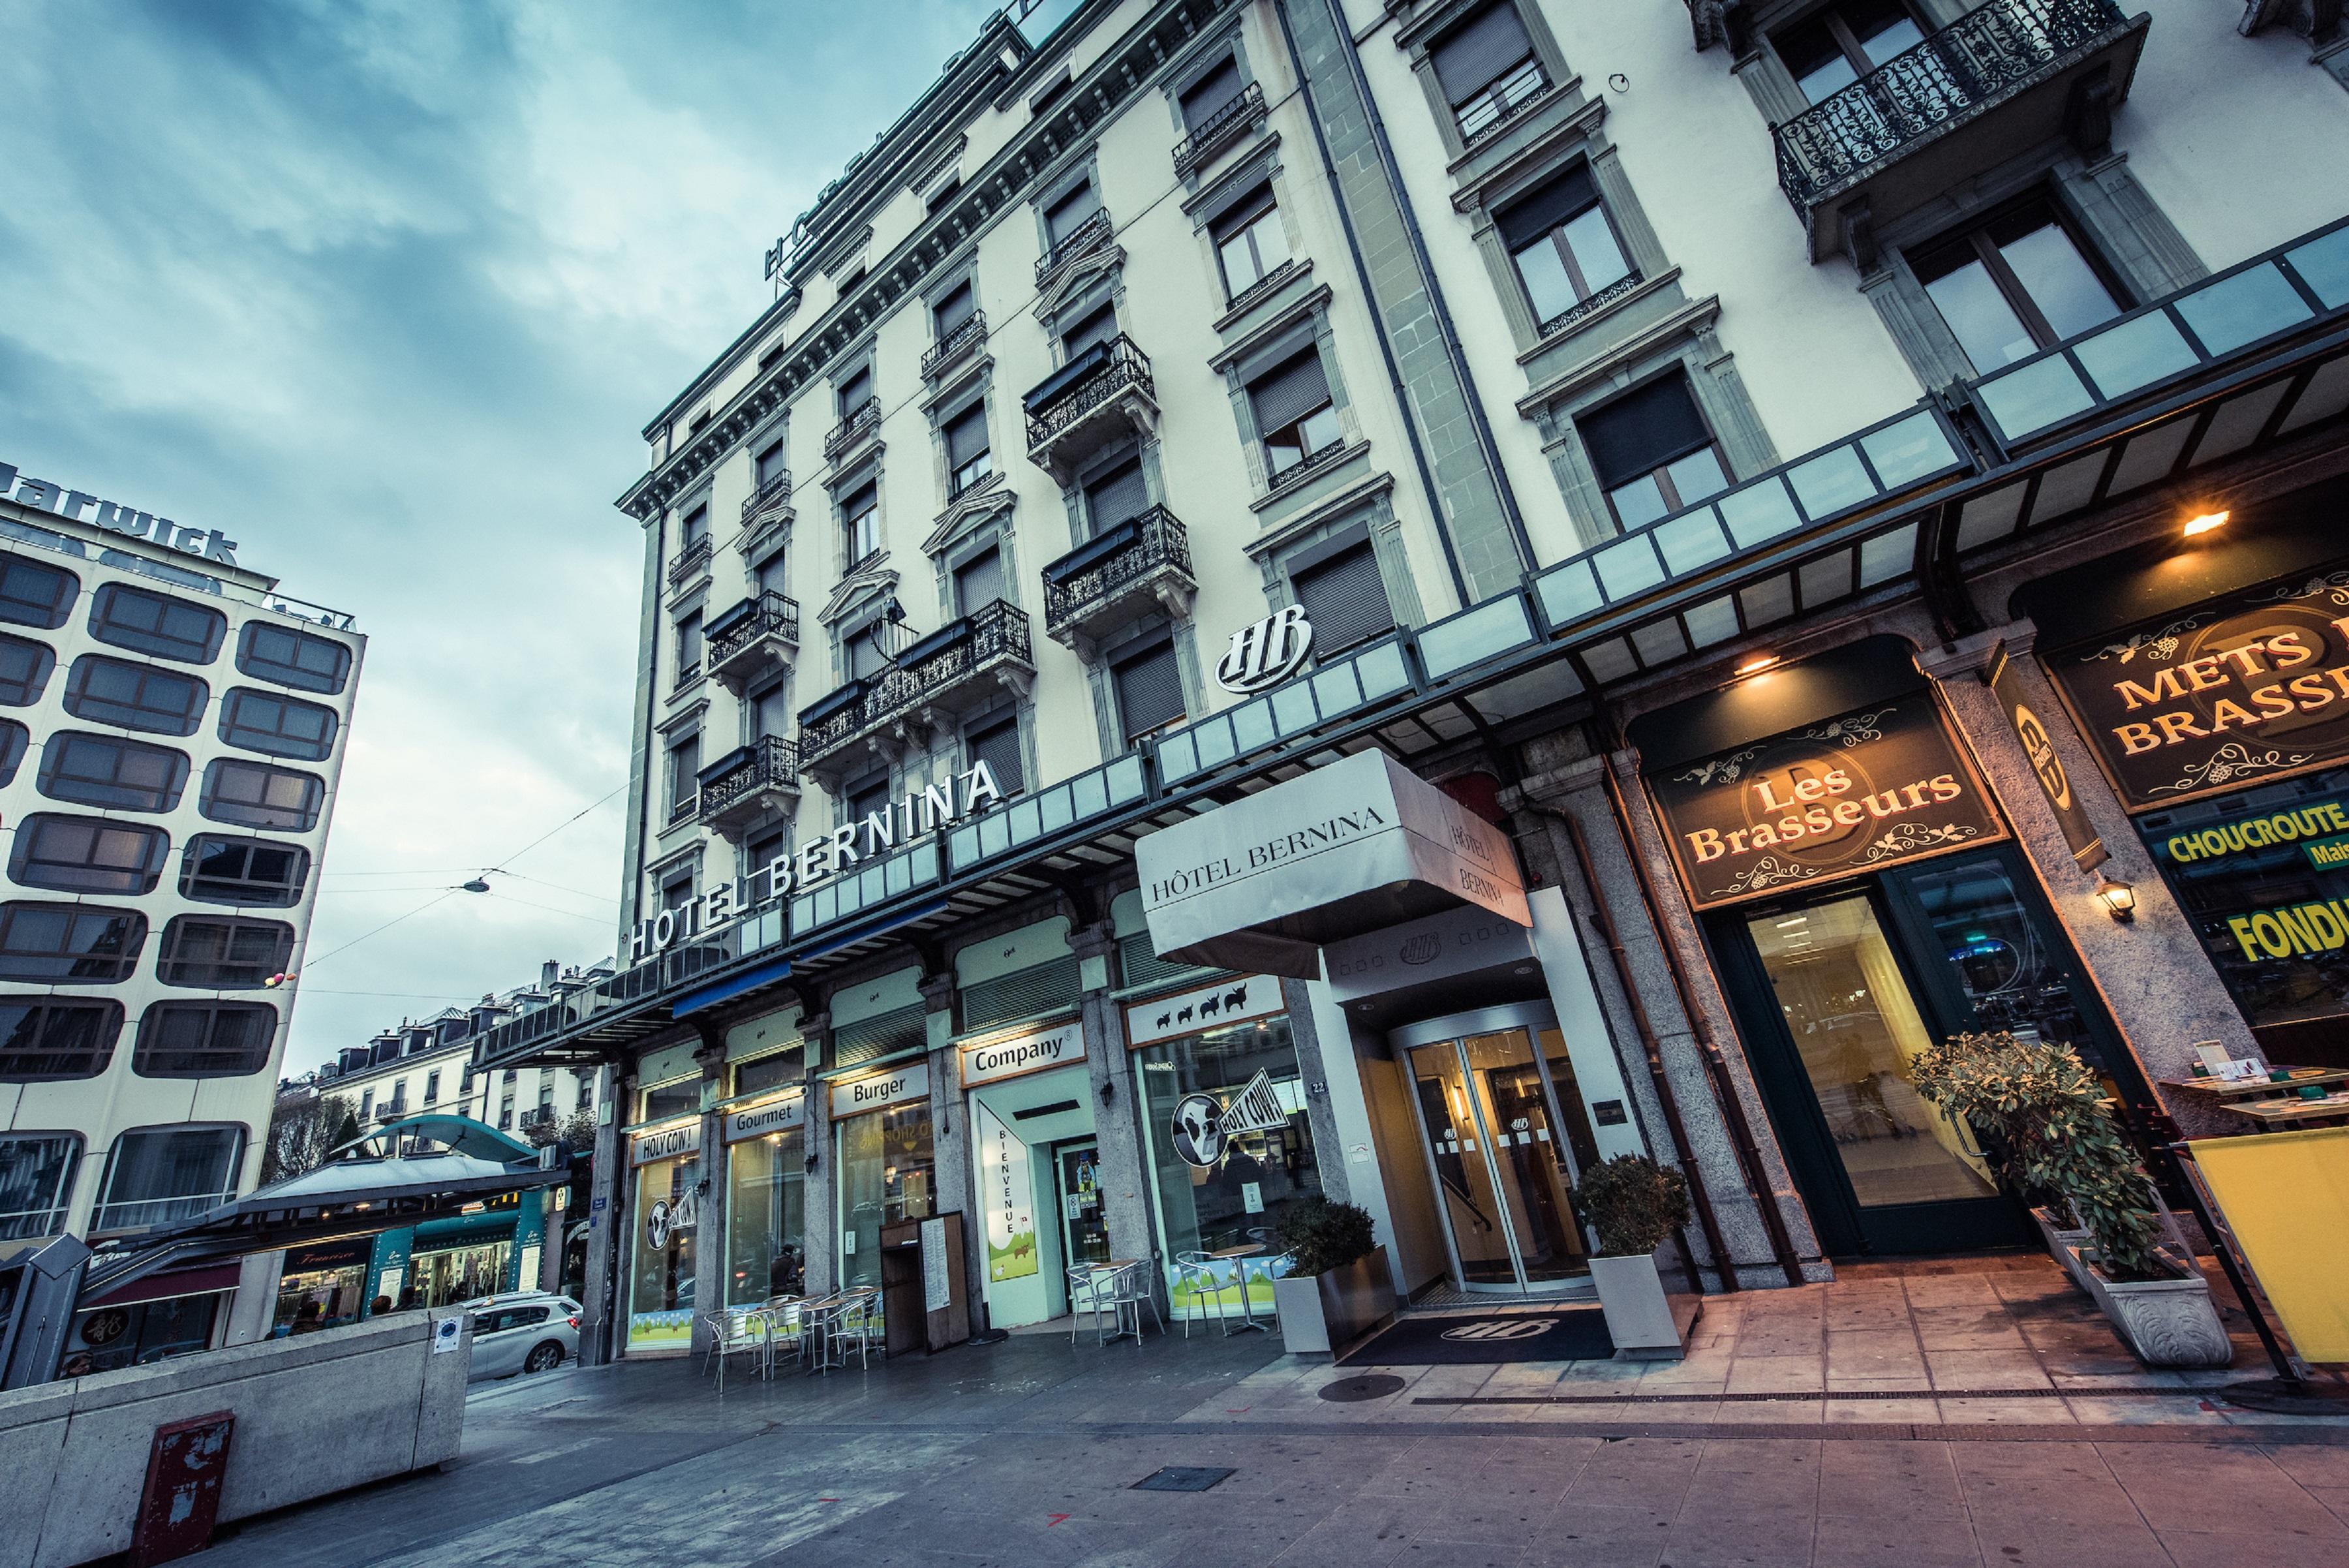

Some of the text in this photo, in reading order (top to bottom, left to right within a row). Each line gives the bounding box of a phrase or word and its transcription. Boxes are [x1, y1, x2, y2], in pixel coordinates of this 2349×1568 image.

[0, 461, 238, 566] arwick
[2113, 632, 2313, 711] METS
[1752, 767, 1853, 813] Les
[1451, 825, 1490, 862] HÔTEL
[1684, 773, 1963, 865] Brasseurs
[2168, 803, 2349, 863] CHOUCROUTE
[630, 760, 1009, 961] HOTEL BERNINA
[1152, 806, 1385, 902] HÔTEL BERNINA
[1459, 867, 1505, 908] BERNINA
[854, 1078, 906, 1102] Burger
[1223, 1103, 1249, 1132] HOLY
[1245, 1078, 1283, 1126] COW!
[1313, 1082, 1325, 1093] 22
[737, 1104, 792, 1130] Gourmet
[643, 1135, 666, 1159] HOLY
[999, 1130, 1014, 1233] BIENVENUE
